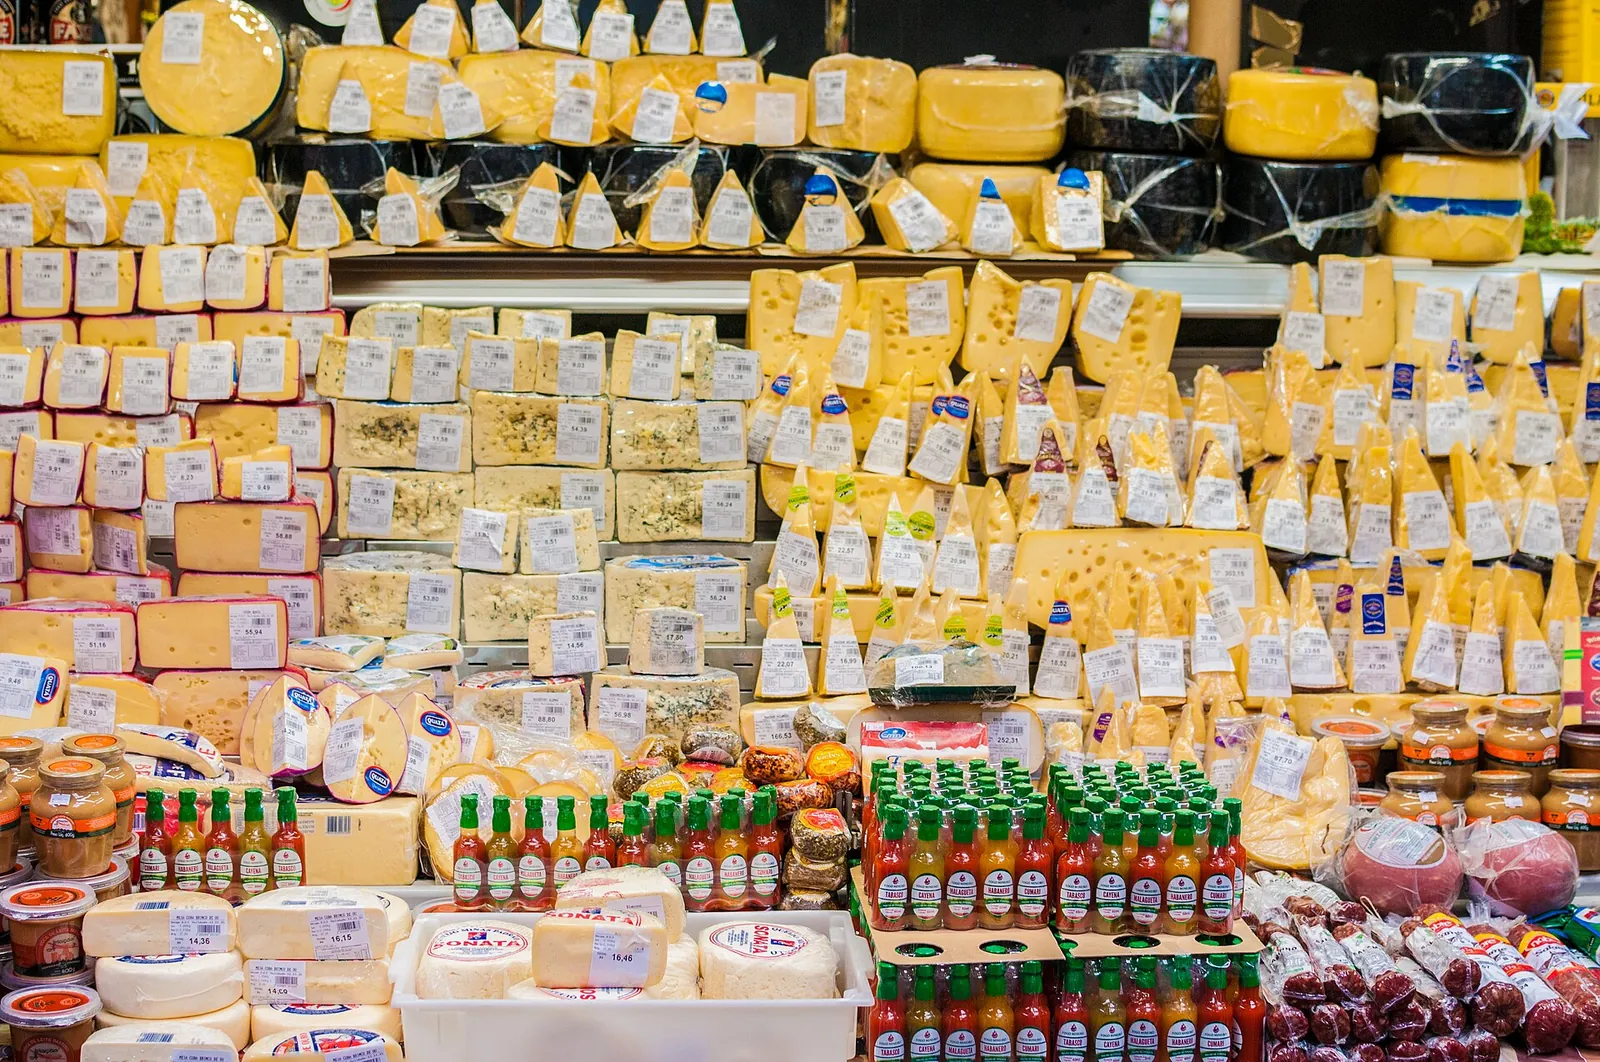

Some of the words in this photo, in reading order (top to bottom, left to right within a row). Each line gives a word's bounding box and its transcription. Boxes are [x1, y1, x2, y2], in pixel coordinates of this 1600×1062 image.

[791, 557, 807, 567] 14,19
[1102, 669, 1119, 678] 27,32
[1274, 755, 1292, 765] 87,70
[1133, 895, 1158, 903] MALAGUETA
[543, 911, 635, 926] SONATA
[331, 934, 352, 942] 16,15
[753, 925, 769, 954] SONATA
[434, 940, 520, 950] SONATA
[612, 953, 633, 962] 16,46
